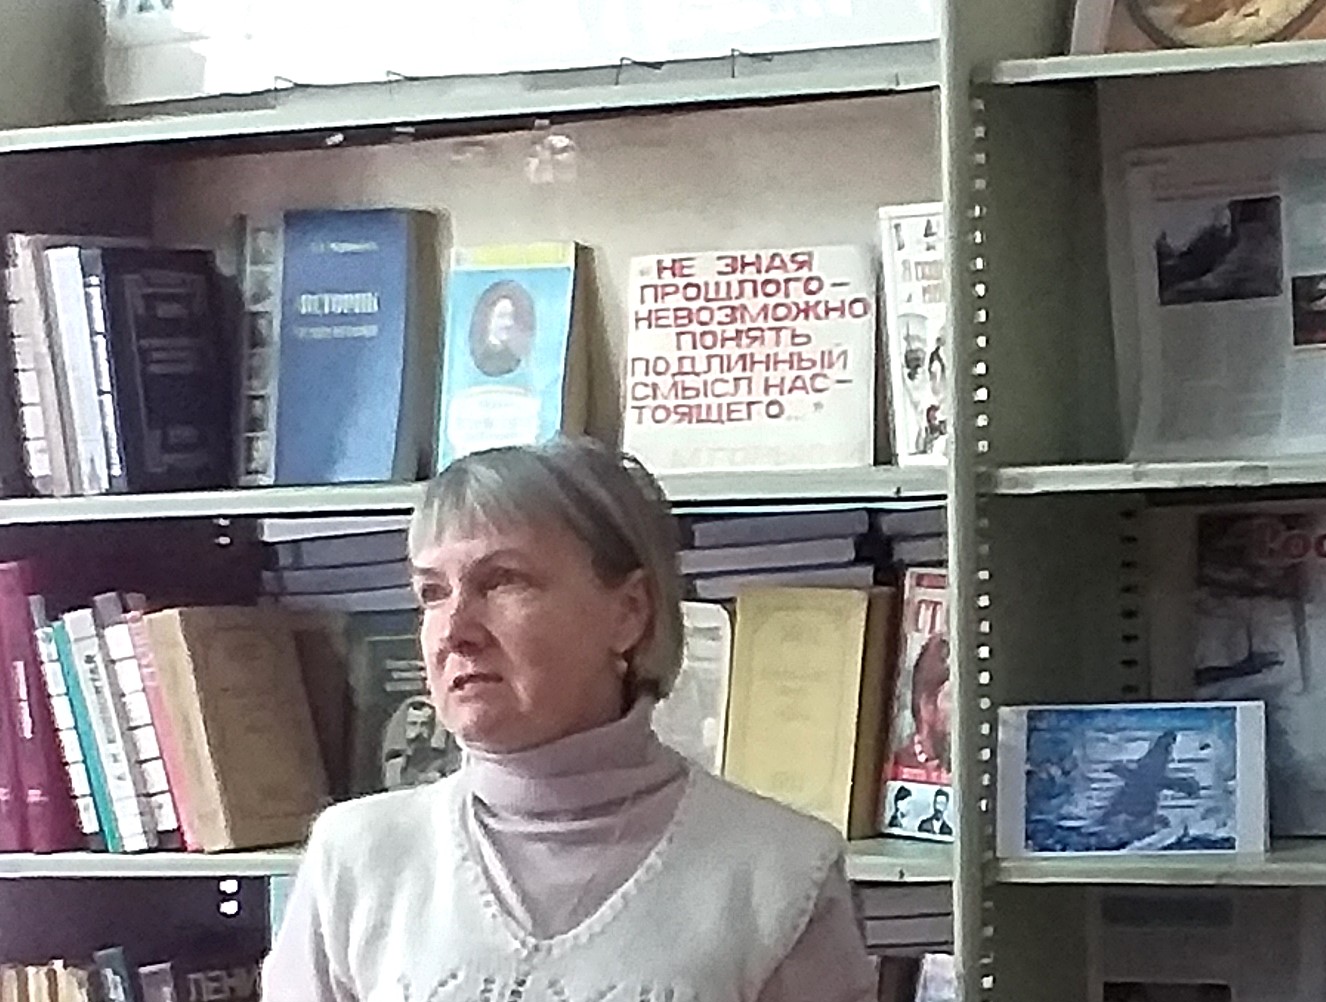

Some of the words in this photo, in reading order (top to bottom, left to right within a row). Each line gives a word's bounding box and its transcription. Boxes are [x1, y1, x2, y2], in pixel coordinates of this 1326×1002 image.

[716, 251, 814, 276] ЗНАЯ
[634, 297, 871, 330] НЕВОЗМОЖНО
[675, 327, 812, 351] ПОНЯТЬ
[630, 347, 849, 378] ПОДЛИННЫЙ
[630, 377, 753, 402] СМЫСЛ
